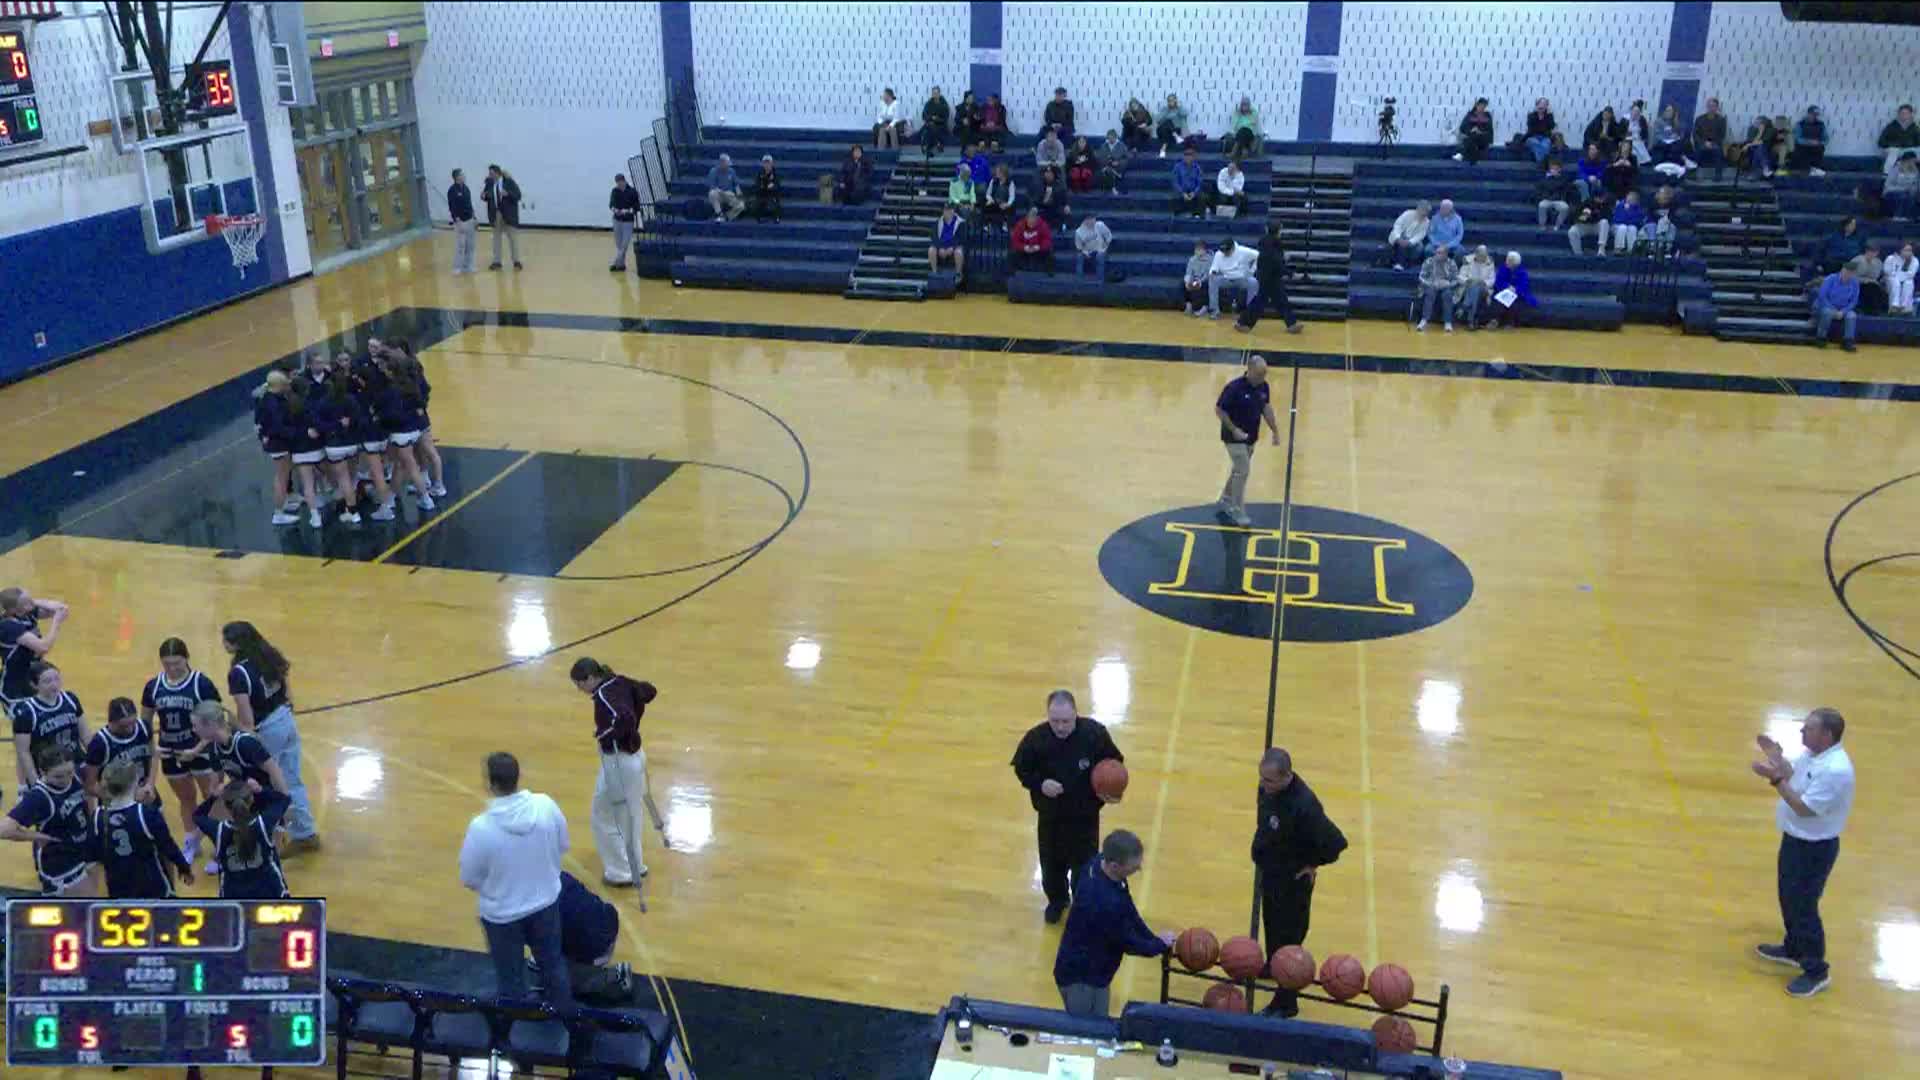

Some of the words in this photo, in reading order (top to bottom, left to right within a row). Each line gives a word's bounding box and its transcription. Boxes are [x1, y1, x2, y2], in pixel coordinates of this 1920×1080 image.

[12, 51, 27, 78] 0
[205, 71, 235, 106] 35
[25, 109, 38, 131] 0
[111, 828, 133, 857] 3
